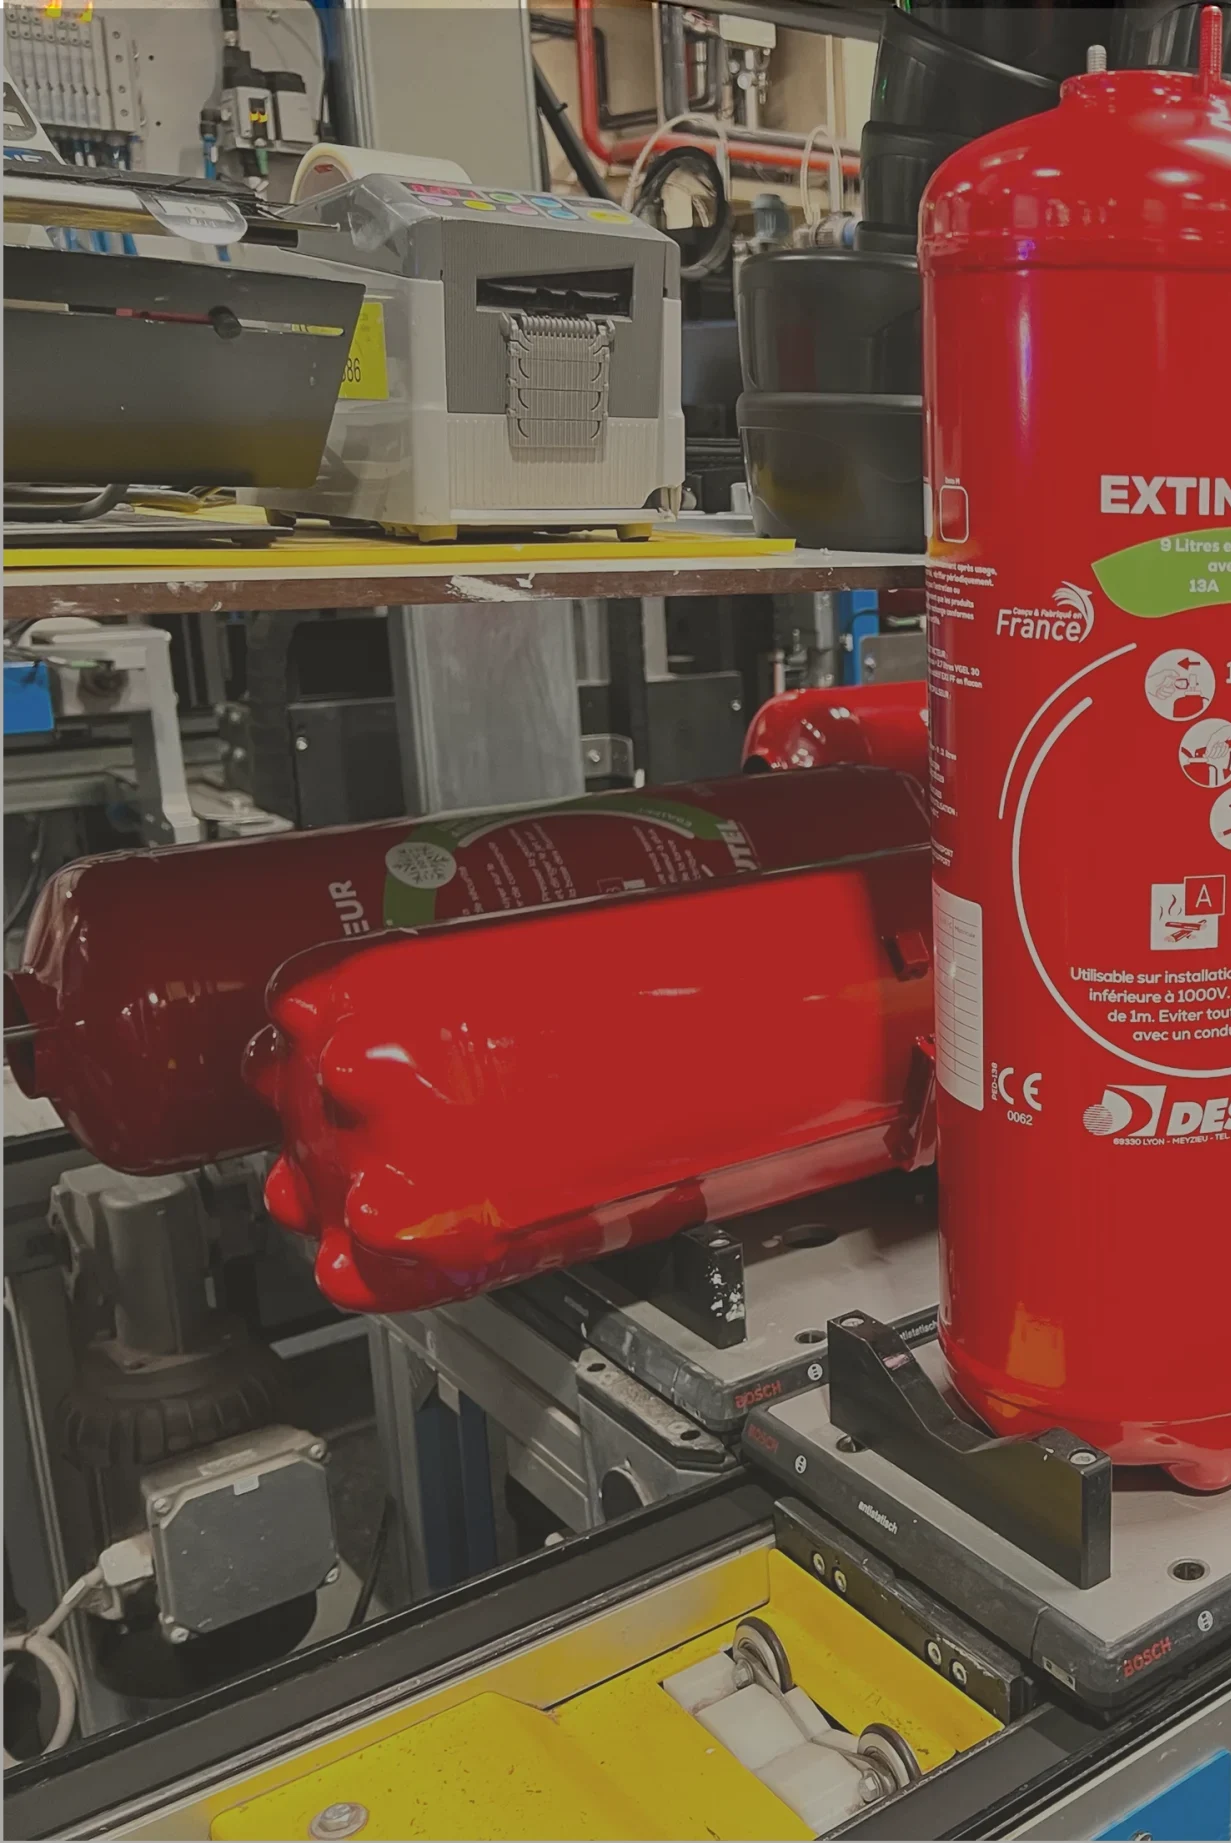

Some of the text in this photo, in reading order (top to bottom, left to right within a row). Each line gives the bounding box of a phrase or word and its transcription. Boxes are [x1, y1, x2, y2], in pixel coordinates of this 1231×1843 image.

[1160, 537, 1171, 552] 9
[1175, 538, 1220, 552] Litres
[1189, 579, 1219, 592] 13A
[996, 608, 1081, 642] France
[1195, 884, 1212, 908] A
[1070, 966, 1134, 984] Utilisable
[1137, 973, 1162, 984] sur
[1089, 988, 1162, 1004] inférieure
[1164, 990, 1175, 1004] à
[1178, 986, 1231, 1003] 1000V.
[1107, 1009, 1127, 1022] de
[1130, 1010, 1155, 1022] 1m.
[1159, 1009, 1203, 1023] Eviter
[1132, 1030, 1168, 1042] avec
[1172, 1030, 1191, 1041] un
[1007, 1110, 1033, 1126] 0062
[1143, 1138, 1165, 1146] LYON
[1172, 1136, 1208, 1144] MEYZIEU
[900, 1320, 938, 1341] tistatisch
[735, 1380, 782, 1408] BOSCH
[858, 1500, 898, 1534] antistatisch
[1123, 1636, 1172, 1678] BOSCH
